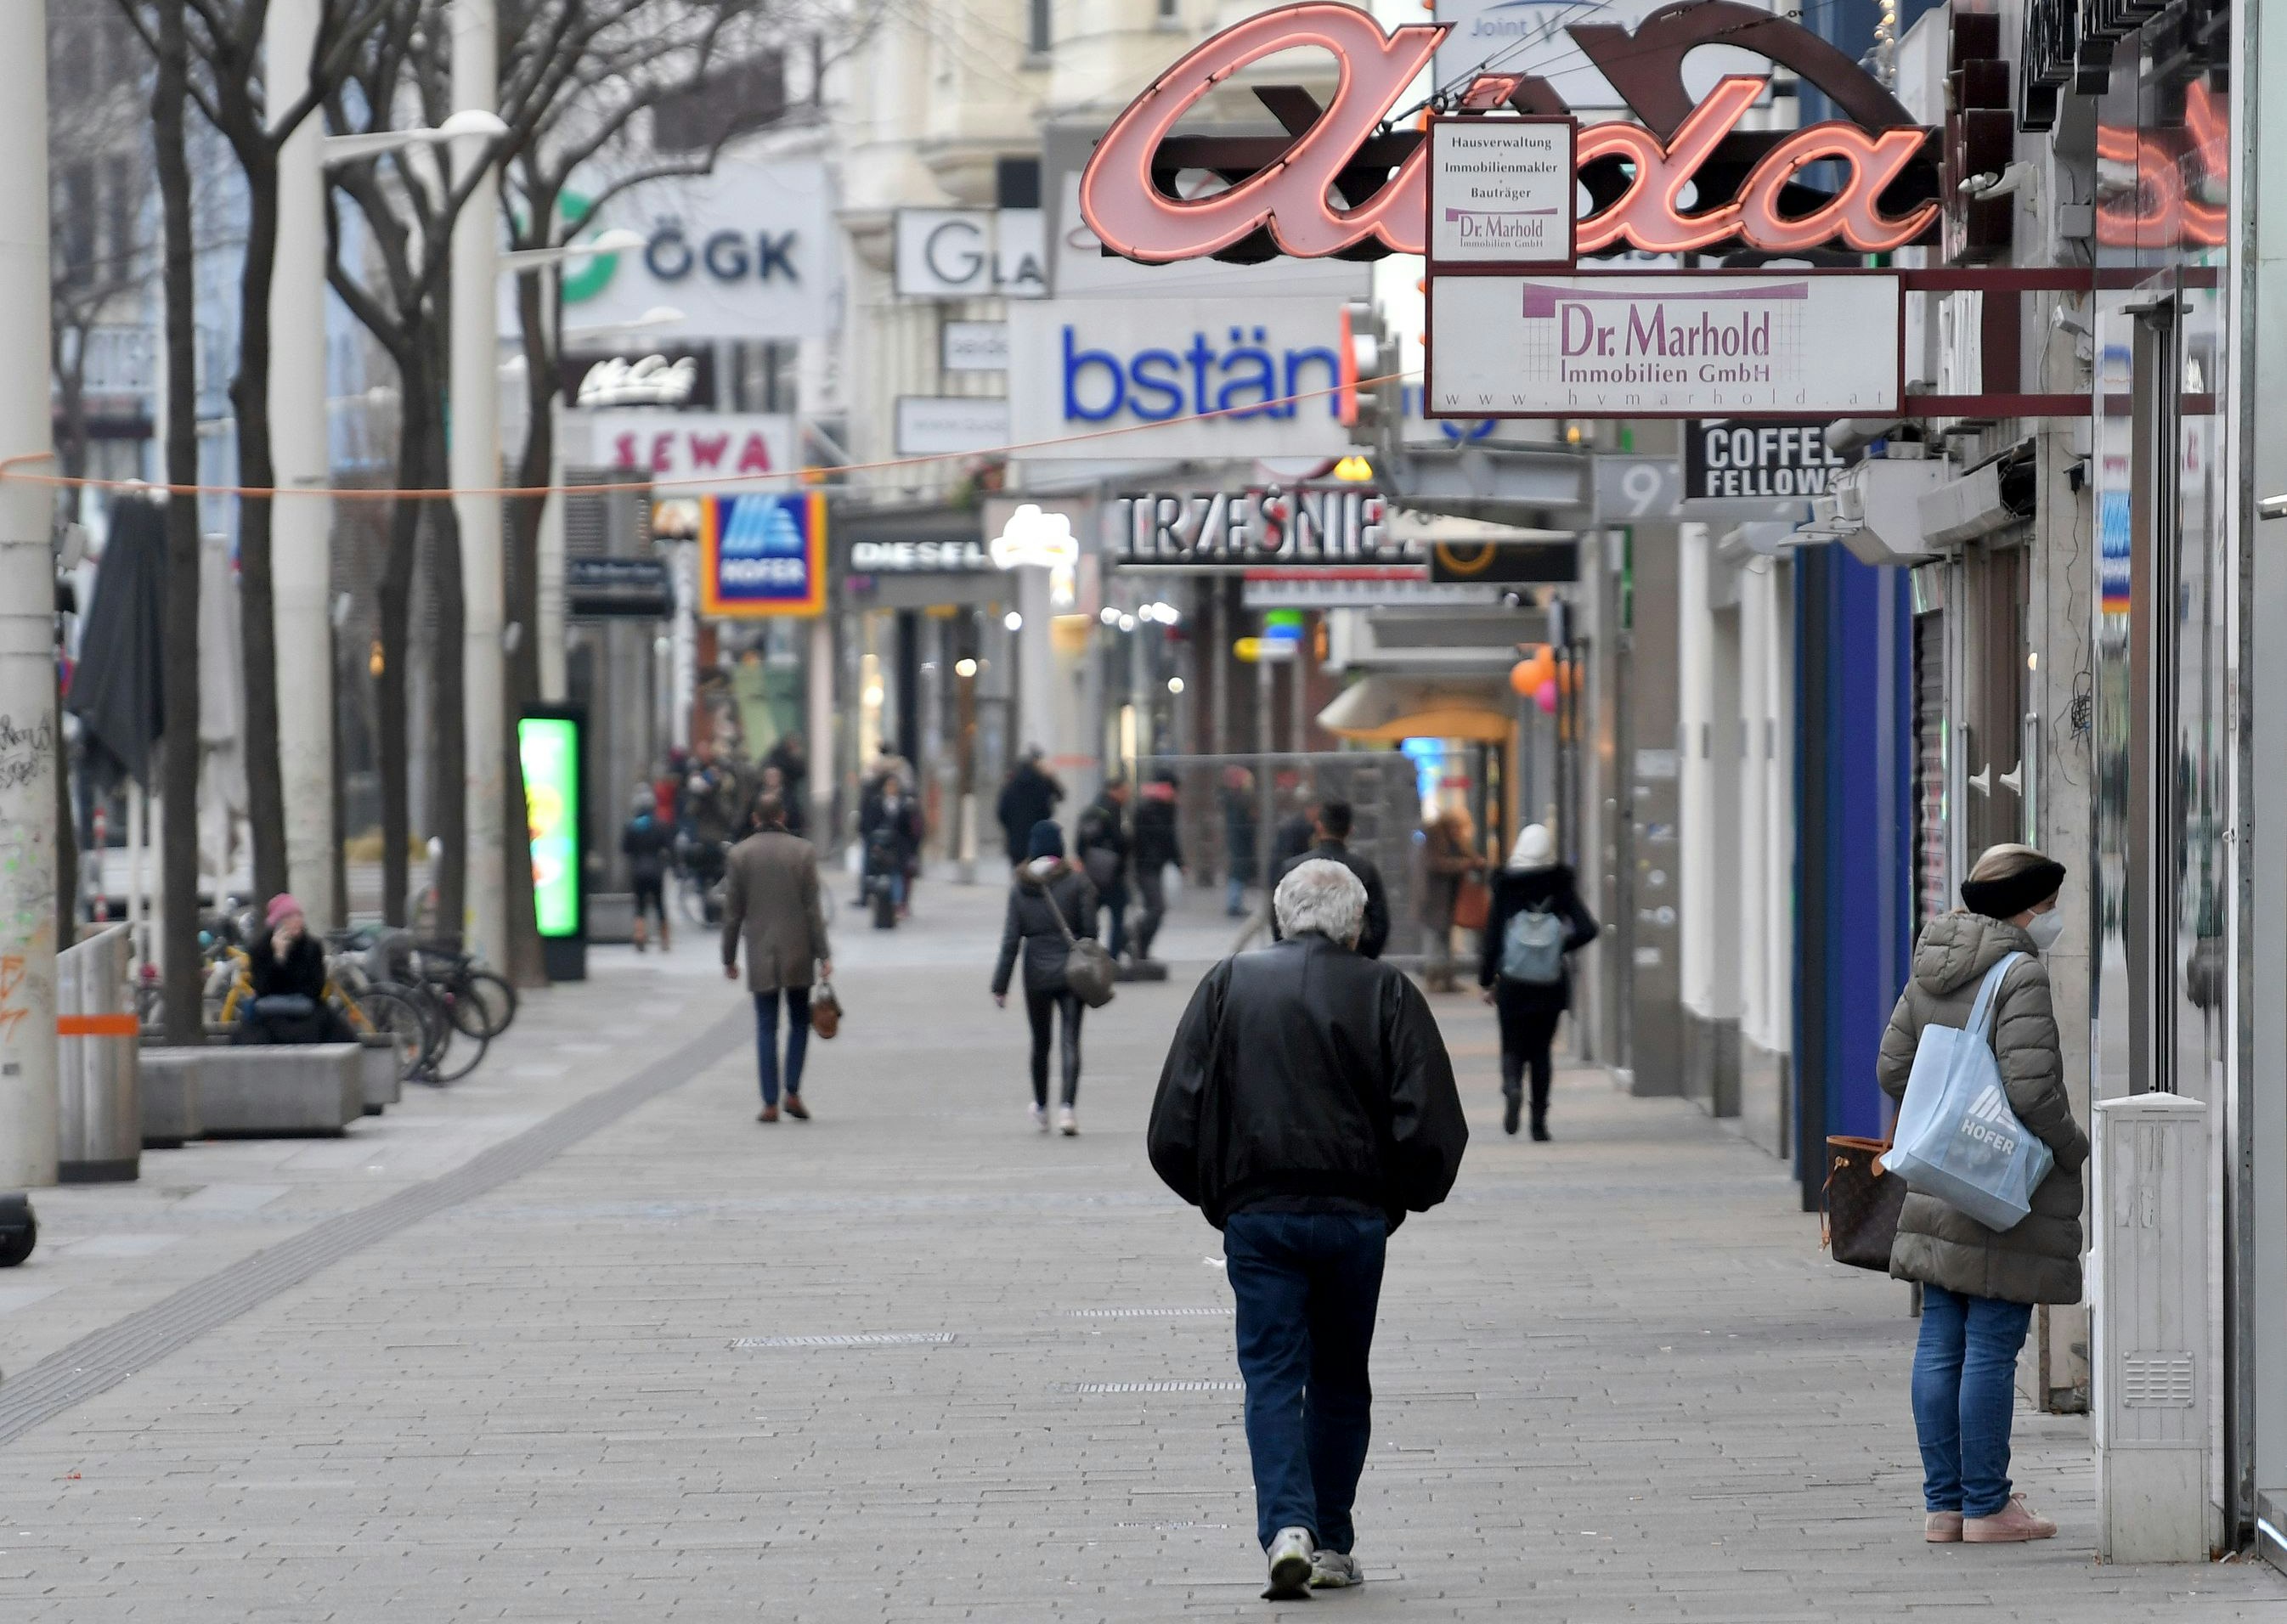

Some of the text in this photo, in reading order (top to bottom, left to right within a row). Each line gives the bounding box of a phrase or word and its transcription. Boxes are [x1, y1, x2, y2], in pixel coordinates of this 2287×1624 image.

[1451, 137, 1552, 150] Hausverwaltung
[1445, 161, 1558, 173] Immobilienmakler
[1471, 187, 1531, 200] Bauträger
[1460, 216, 1543, 237] Dr. Marhold
[644, 217, 799, 282] ÖGK
[1460, 238, 1543, 247] Immobilien GmbH
[1561, 302, 1770, 357] Dr. Marhold
[1561, 358, 1770, 383] Immobilien GmbH
[612, 430, 772, 472] SEWA
[1961, 1119, 2014, 1155] HOFER
